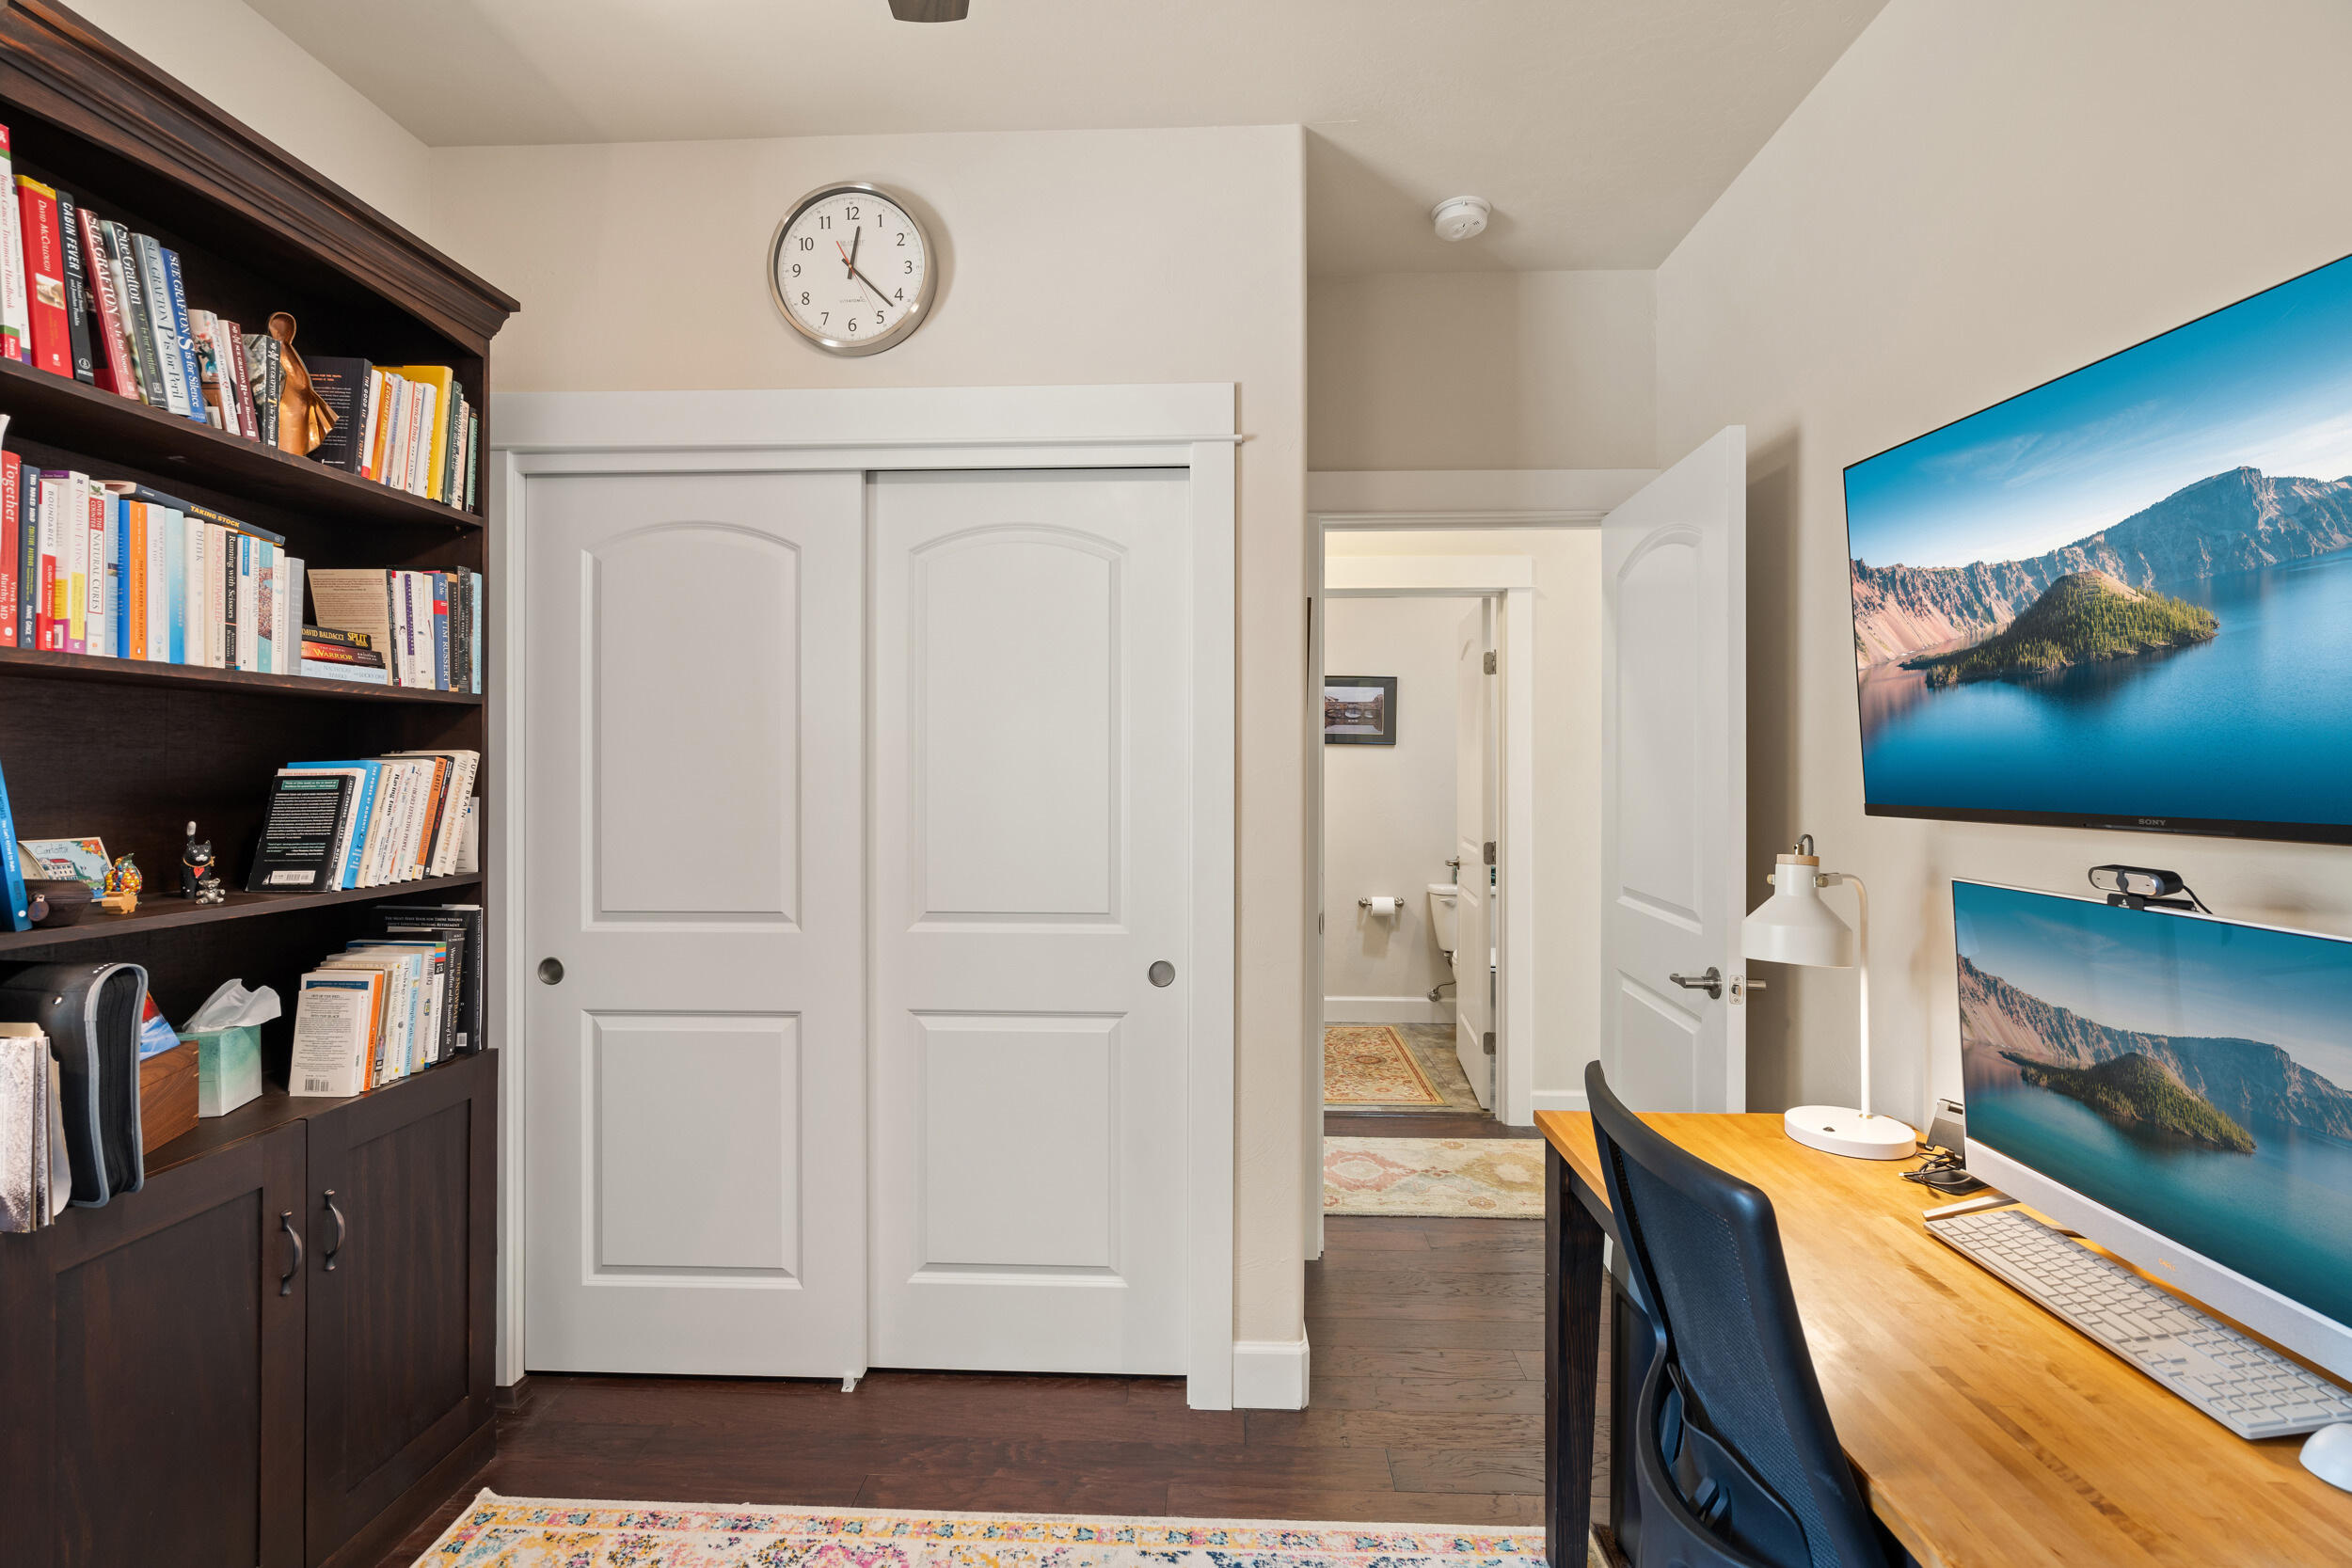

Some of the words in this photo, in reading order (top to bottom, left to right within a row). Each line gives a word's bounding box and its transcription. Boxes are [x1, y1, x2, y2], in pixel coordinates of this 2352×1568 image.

[1, 200, 10, 228] Cancer
[38, 199, 48, 222] DAVID
[63, 202, 76, 235] CABIN
[846, 206, 860, 221] 12
[878, 214, 882, 228] 1
[87, 215, 102, 243] SUE
[819, 215, 832, 230] 11
[3, 230, 13, 267] Treatment
[117, 230, 131, 255] Sue
[799, 237, 814, 251] 10
[897, 232, 905, 246] 2
[67, 237, 80, 271] FEVER
[146, 240, 158, 262] SUE
[169, 255, 180, 277] SUE
[792, 263, 801, 277] 9
[904, 261, 913, 275] 3
[5, 268, 14, 309] Handbook
[91, 247, 119, 316] GRAFTON
[122, 256, 141, 305] Grafton
[151, 266, 167, 321] GRAFTON
[802, 292, 810, 306] 8
[894, 287, 903, 301] 4
[173, 279, 190, 335] GRAFTON
[820, 312, 829, 325] 7
[877, 310, 884, 325] 5
[158, 325, 174, 340] P
[848, 318, 857, 332] 6
[141, 335, 151, 347] for
[164, 341, 171, 349] is
[177, 336, 195, 352] S
[119, 352, 129, 374] Noose
[165, 350, 176, 369] for
[185, 358, 195, 373] for
[168, 372, 183, 399] Peril
[187, 375, 199, 407] Silence
[268, 398, 278, 406] T
[268, 416, 277, 439] Trespass
[2, 463, 19, 522] Together
[190, 505, 217, 520] TAKING
[217, 515, 240, 528] STOCK
[91, 532, 102, 577] NATURAL
[196, 531, 204, 562] blink
[227, 536, 235, 568] Running
[0, 573, 8, 600] Murthy,
[91, 578, 102, 610] CURES
[1, 602, 8, 620] MD
[10, 604, 16, 614] H.
[301, 628, 318, 637] DAVID
[319, 631, 344, 641] BALDACCI
[347, 632, 368, 641] SPLIT
[313, 648, 353, 660] WARRIOR
[467, 758, 476, 785] PUPPY
[368, 777, 376, 796] POWER
[389, 773, 400, 799] Raving
[449, 773, 465, 814] Atomic
[342, 795, 351, 817] JENNINGS
[387, 800, 395, 816] Fans
[461, 790, 470, 818] BRAIN
[360, 806, 370, 832] MOMENTS
[442, 816, 455, 851] Habits
[401, 967, 409, 995] Psychology
[453, 976, 461, 1025] SNOWBALL
